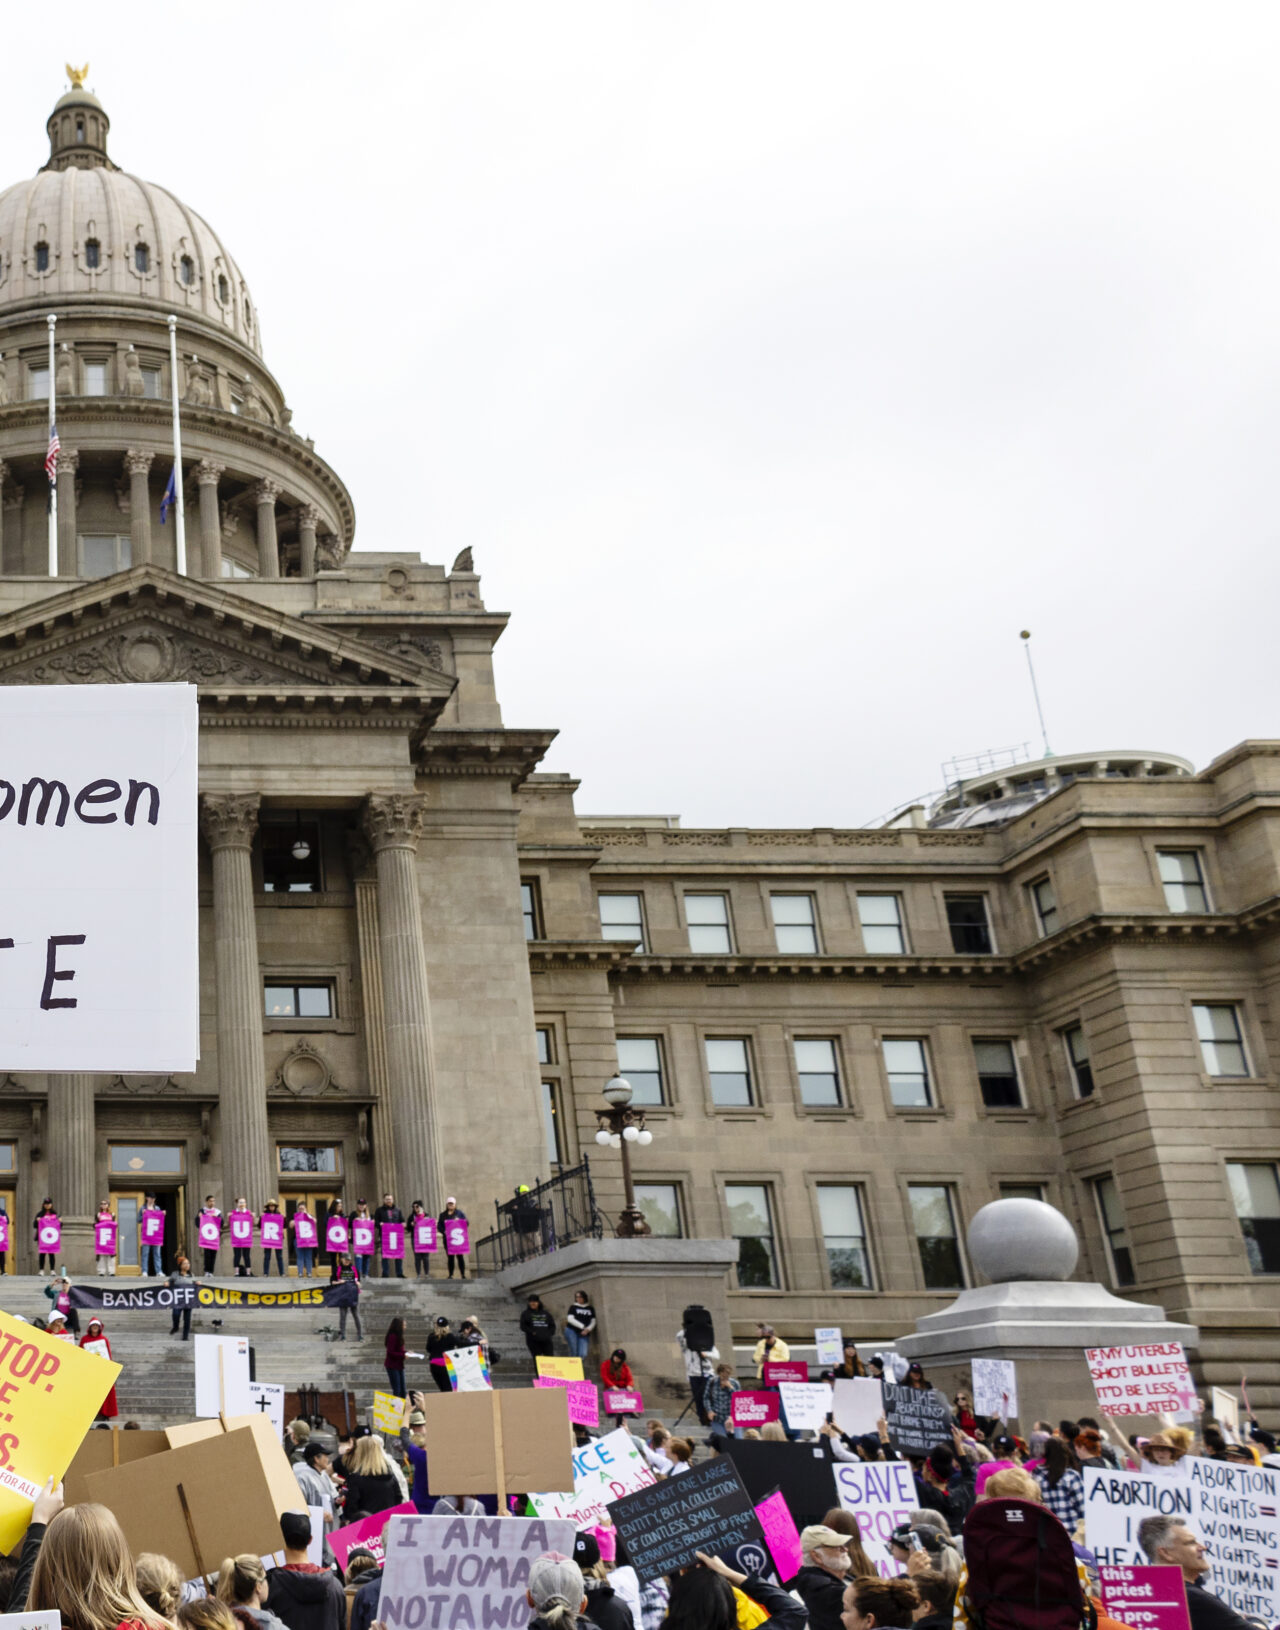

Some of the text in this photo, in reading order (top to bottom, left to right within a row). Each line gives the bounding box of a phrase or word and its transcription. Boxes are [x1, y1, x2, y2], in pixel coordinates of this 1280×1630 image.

[102, 1287, 325, 1307] BANS OFF OUR BODIES
[1087, 1342, 1181, 1361] IF MY UTERUS
[1090, 1361, 1189, 1380] SHOT BULLETS
[1125, 1383, 1143, 1396] BE
[1144, 1381, 1178, 1395] LESS
[1101, 1400, 1181, 1417] REGULATED
[572, 1442, 615, 1481] ICE
[0, 1471, 20, 1488] FOR
[17, 1480, 37, 1498] ALL
[599, 1470, 614, 1484] A
[646, 1494, 657, 1507] IS
[656, 1485, 676, 1503] NOT
[676, 1476, 699, 1494] ONE
[699, 1462, 731, 1485] LARGE
[838, 1465, 914, 1504] SAVE
[1191, 1461, 1276, 1496] ABORTION
[660, 1502, 681, 1520] BUT
[680, 1499, 690, 1511] A
[688, 1478, 740, 1507] COLLECTION
[1089, 1476, 1192, 1515] ABORTION
[1200, 1491, 1257, 1519] RIGHTS
[396, 1517, 549, 1551] I AM A
[626, 1538, 640, 1553] OF
[687, 1507, 720, 1527] SMALL
[632, 1538, 683, 1567] DEPRAVITIES
[682, 1523, 718, 1546] BROUGHT
[718, 1519, 729, 1531] UP
[728, 1508, 756, 1528] FROM
[1198, 1518, 1278, 1549] WOMENS
[639, 1564, 659, 1579] THE
[658, 1555, 680, 1573] MUCK
[679, 1550, 691, 1564] BY
[1203, 1541, 1262, 1568] RIGHTS
[423, 1553, 531, 1589] WOMA
[1102, 1566, 1134, 1580] this
[1212, 1564, 1274, 1591] HUMAN
[1104, 1582, 1153, 1598] priest
[380, 1593, 451, 1630] NOT
[481, 1594, 531, 1630] WO
[1107, 1607, 1159, 1624] is pro-
